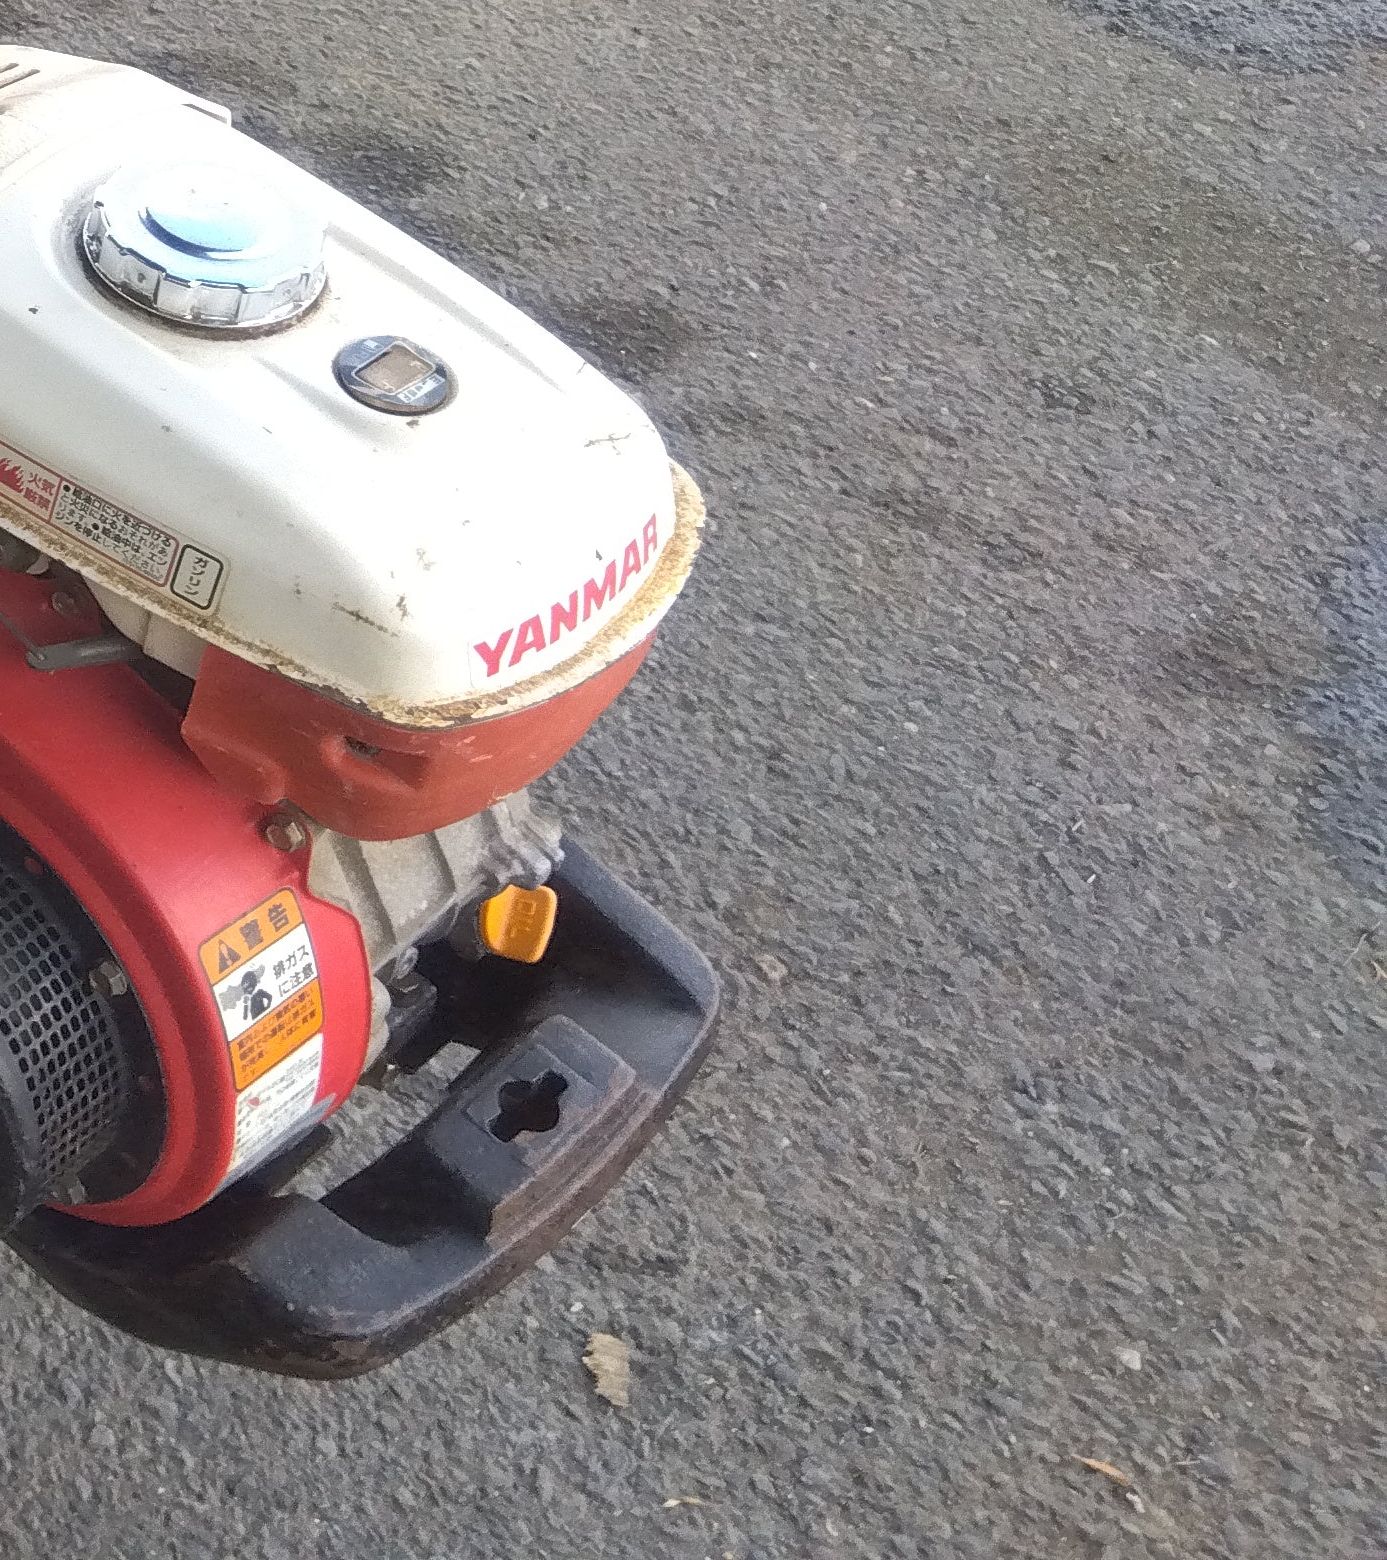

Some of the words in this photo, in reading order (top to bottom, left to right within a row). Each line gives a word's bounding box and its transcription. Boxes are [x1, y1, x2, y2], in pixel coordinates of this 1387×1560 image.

[28, 472, 56, 496] 火気
[184, 556, 210, 595] ガソリン
[473, 513, 657, 677] YANMAR
[239, 903, 289, 951] 警告
[273, 945, 310, 979] 排ガス
[278, 962, 315, 997] に注意
